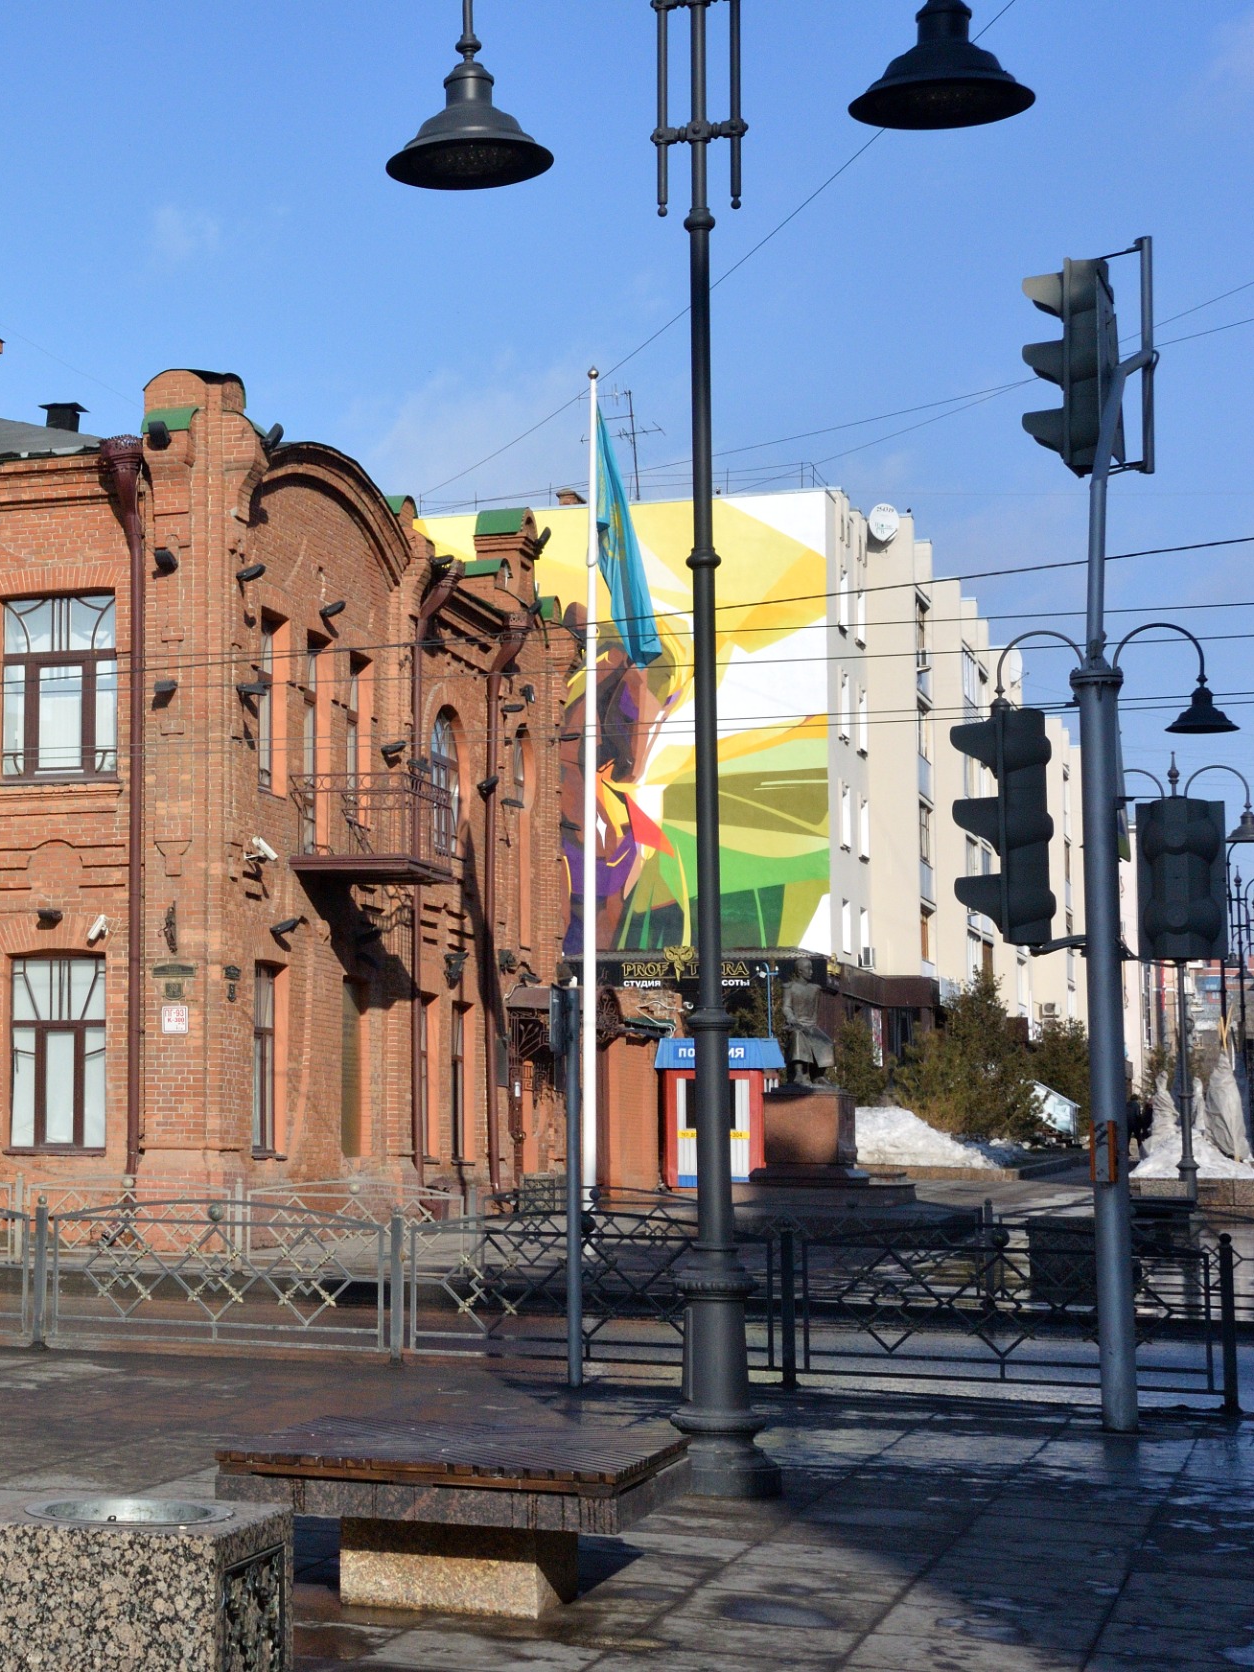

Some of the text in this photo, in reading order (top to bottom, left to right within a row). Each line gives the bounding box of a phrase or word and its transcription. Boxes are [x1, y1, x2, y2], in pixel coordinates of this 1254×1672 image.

[622, 961, 750, 977] PROF TRA
[623, 980, 661, 988] студия
[678, 1047, 745, 1058] ПОИЯ
